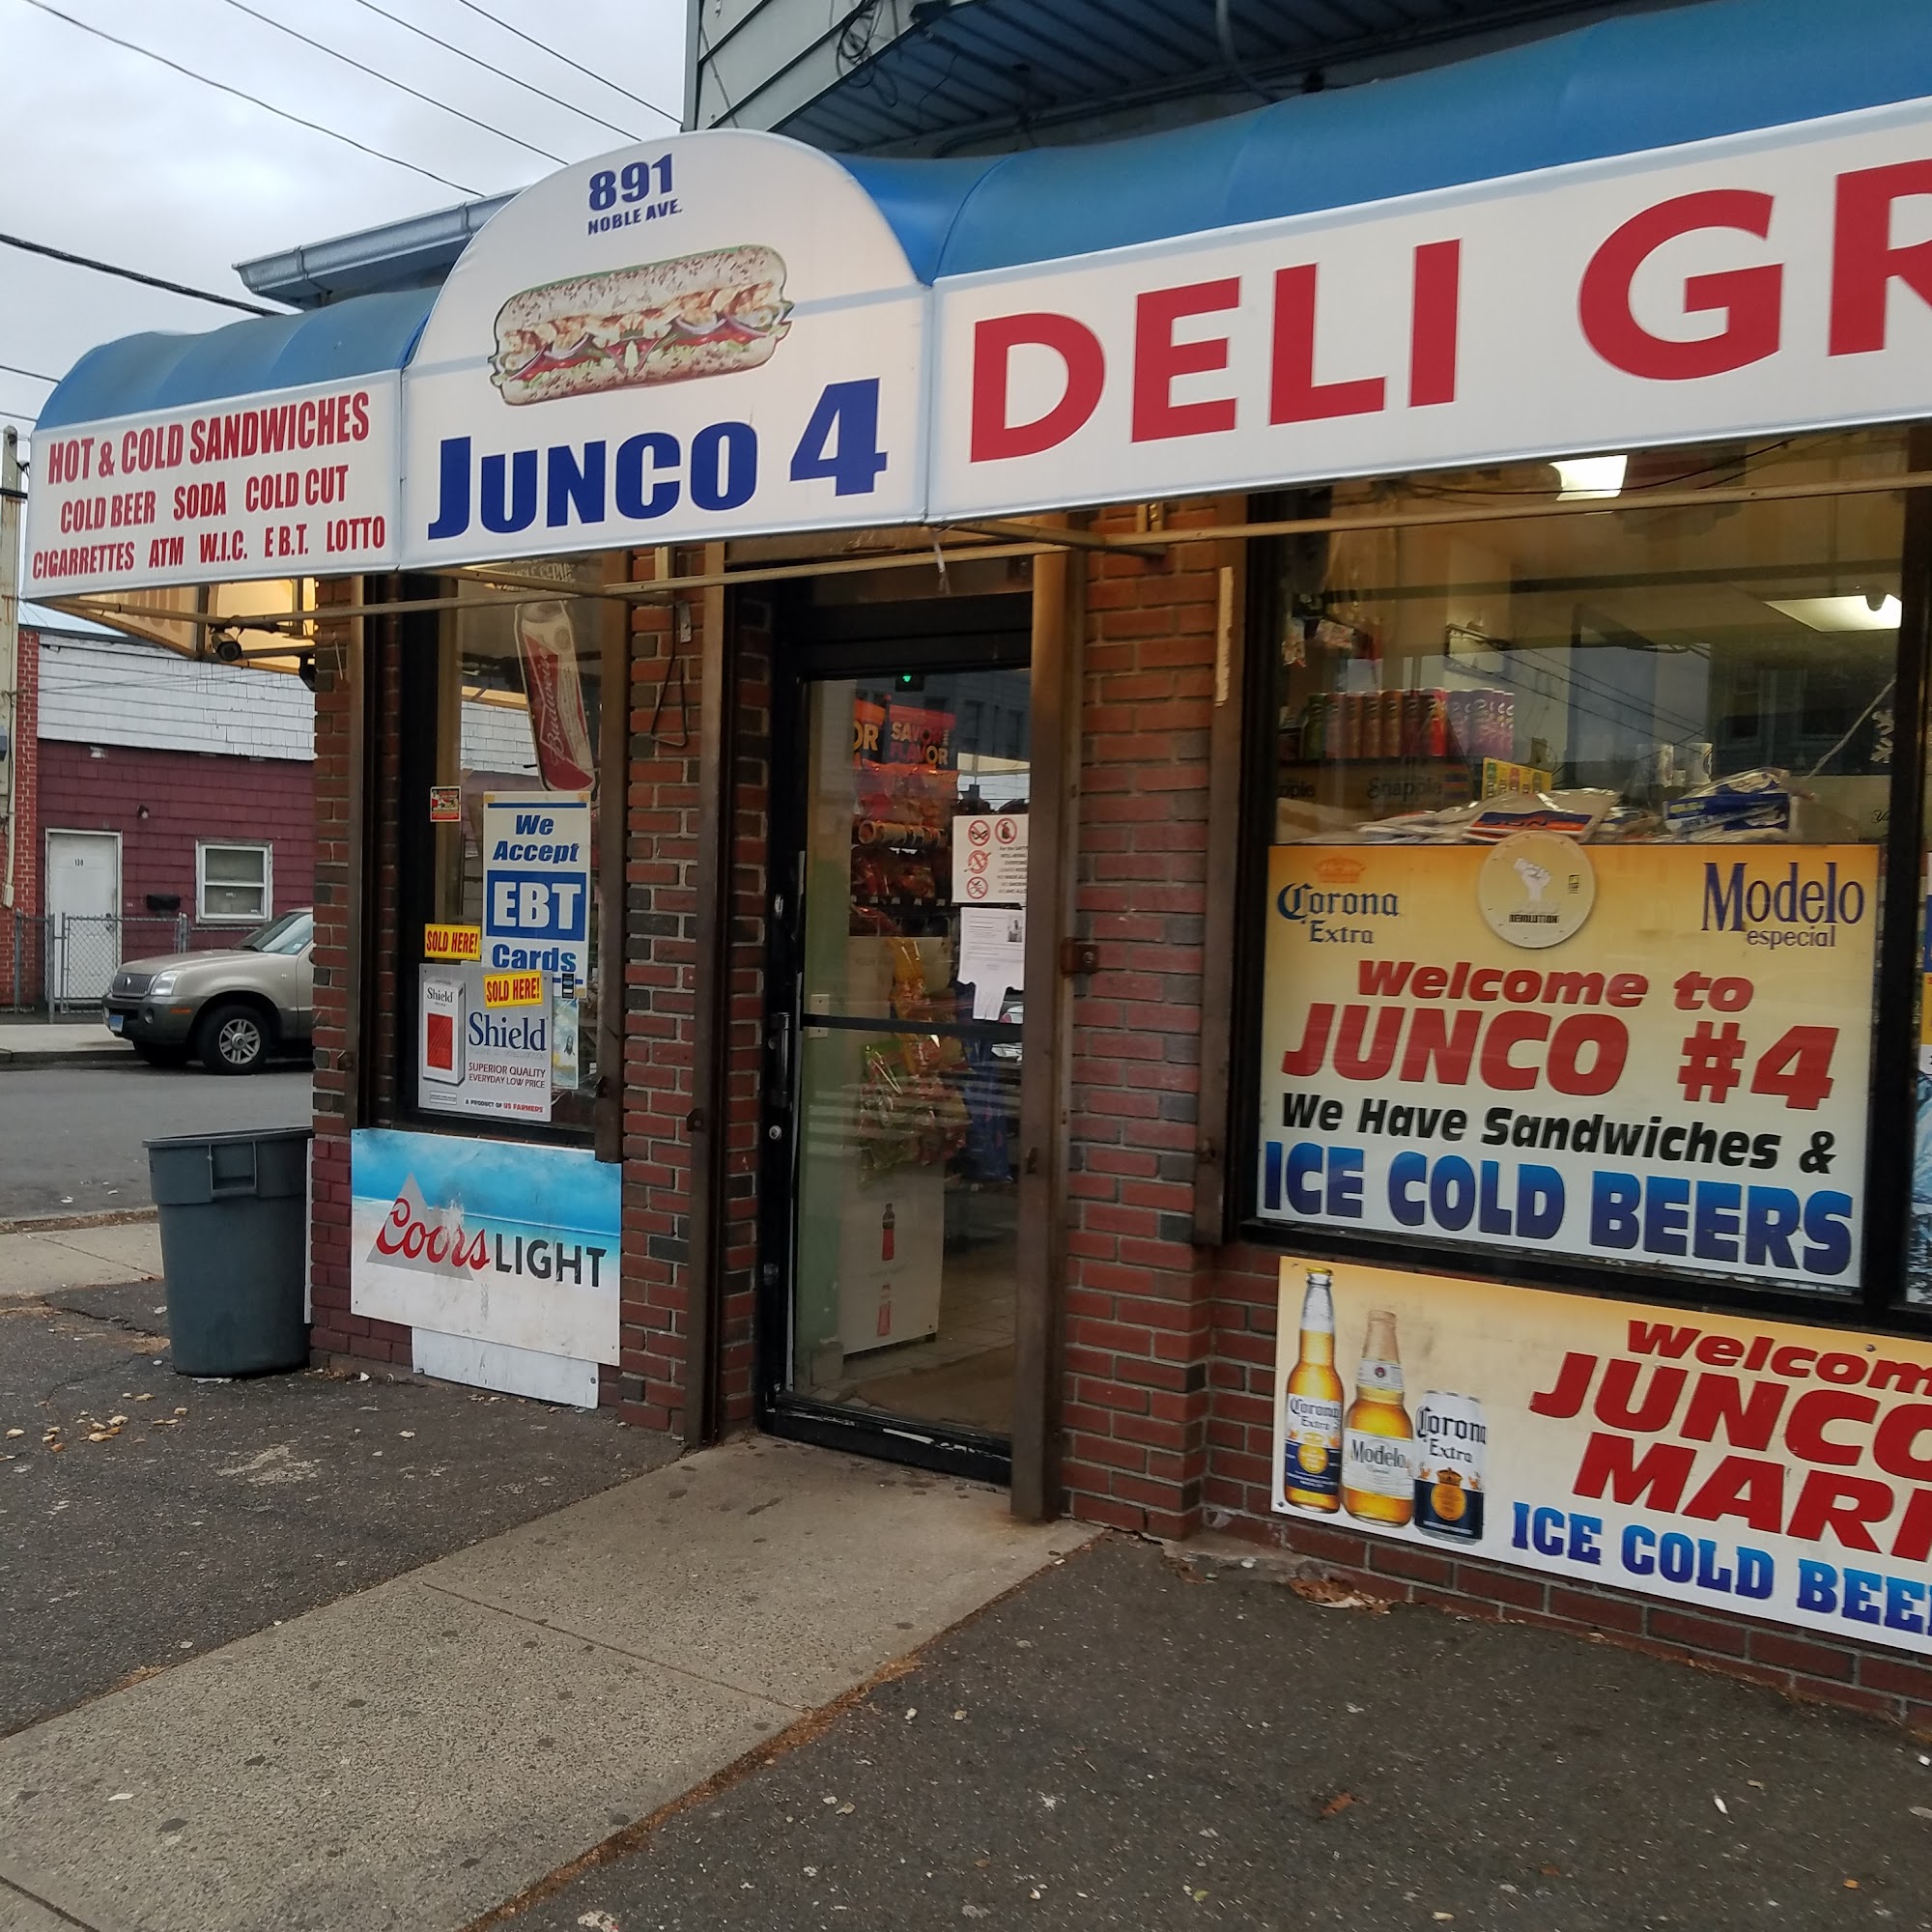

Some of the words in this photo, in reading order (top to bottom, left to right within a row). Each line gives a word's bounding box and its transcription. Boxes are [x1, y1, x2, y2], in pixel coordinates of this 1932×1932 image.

[589, 153, 673, 211] 891
[587, 208, 641, 236] NOBLE
[969, 238, 1463, 464] DELI
[1577, 158, 1932, 381] GR
[48, 438, 96, 485] HOT
[98, 441, 115, 478] &
[121, 423, 185, 474] COLD
[189, 391, 370, 466] SANDWICHES
[427, 421, 758, 541] JUNCO
[790, 377, 889, 497] 4
[60, 496, 105, 533] COLD
[110, 491, 156, 526] BEER
[173, 481, 227, 522] SODA
[245, 471, 298, 513] COLD
[304, 465, 349, 506] CUT
[32, 542, 135, 581] CIGARRETTES
[148, 536, 185, 569] ATM
[326, 515, 385, 554] LOTTO
[515, 814, 554, 836] We
[492, 840, 580, 864] Accept
[493, 881, 582, 930] EBT
[1276, 882, 1400, 924] Corona
[1700, 862, 1865, 932] Modelo
[426, 930, 449, 952] SOLD
[451, 931, 479, 954] HERE!
[1308, 919, 1375, 945] Extra
[1746, 925, 1837, 950] especial
[492, 943, 577, 973] Cards
[426, 986, 454, 1004] Shield
[486, 980, 509, 1004] SOLD
[512, 977, 541, 1001] HERE!
[1357, 960, 1648, 1008] Welcome
[1673, 970, 1754, 1012] to
[469, 1011, 547, 1051] Shield
[469, 1062, 507, 1074] SUPERIOR
[509, 1065, 547, 1079] QUALITY
[1281, 1003, 1631, 1096] JUNCO
[1677, 1020, 1840, 1111] #4
[469, 1073, 505, 1084] EVERYDAY
[506, 1077, 524, 1087] LOW
[525, 1079, 546, 1089] PRICE
[470, 1099, 495, 1109] PRODUCT
[513, 1103, 545, 1114] FARMERS
[1281, 1093, 1344, 1132] We
[1357, 1097, 1467, 1142] Have
[1482, 1106, 1782, 1171] Sandwiches
[1798, 1129, 1837, 1175] &
[1264, 1141, 1365, 1219] ICE
[1387, 1151, 1566, 1241] COLD
[1588, 1169, 1855, 1277] BEERS
[375, 1197, 490, 1270] Coors
[495, 1233, 607, 1288] LIGHT
[1627, 1320, 1932, 1397] Welcom
[1529, 1351, 1932, 1483] JUNCO
[1350, 1438, 1406, 1468] Modelo
[1429, 1438, 1473, 1463] Extra
[1512, 1501, 1604, 1566] ICE
[1621, 1524, 1775, 1601] COLD
[1797, 1557, 1932, 1637] BEE
